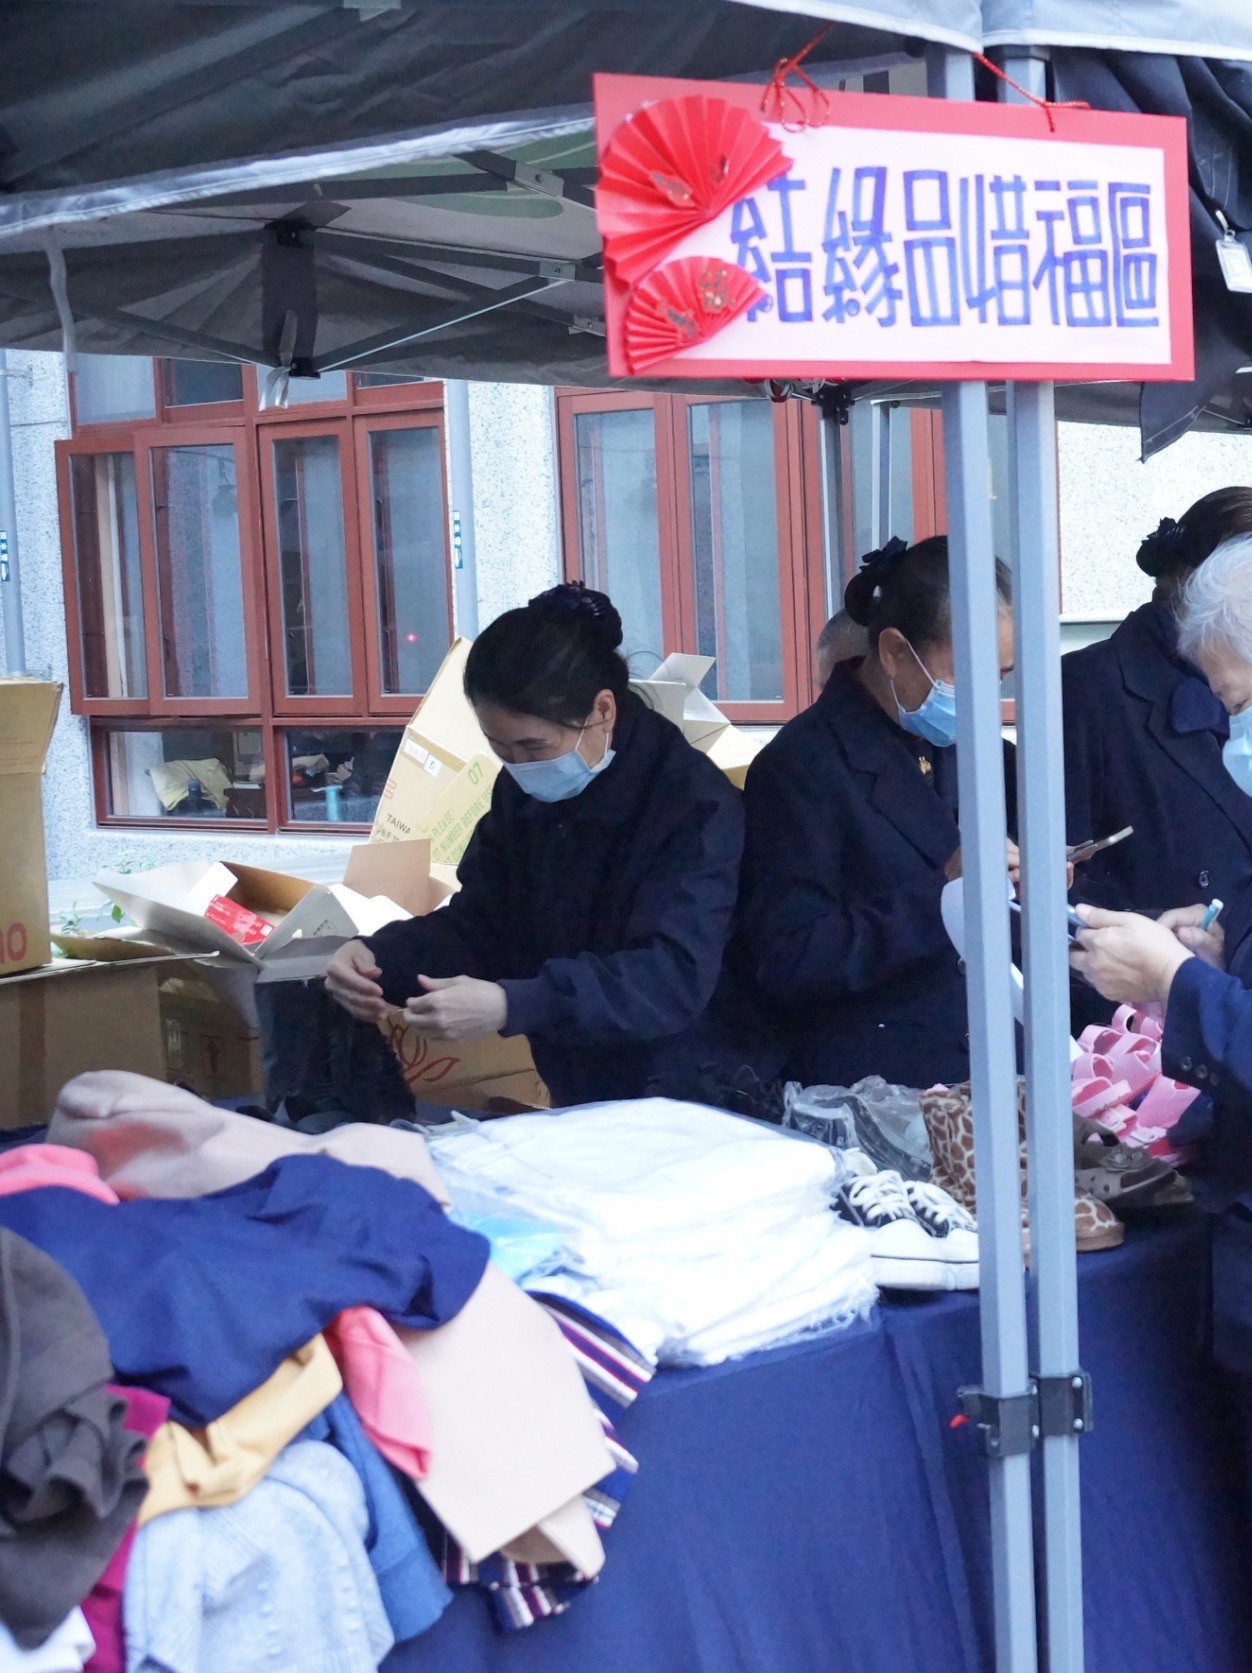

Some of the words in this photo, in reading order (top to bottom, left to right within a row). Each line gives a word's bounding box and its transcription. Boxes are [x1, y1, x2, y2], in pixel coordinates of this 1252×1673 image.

[730, 166, 1159, 328] 結緣品惜福區
[467, 761, 485, 786] 07
[387, 813, 411, 834] TAIWA
[461, 797, 485, 827] BEFORE
